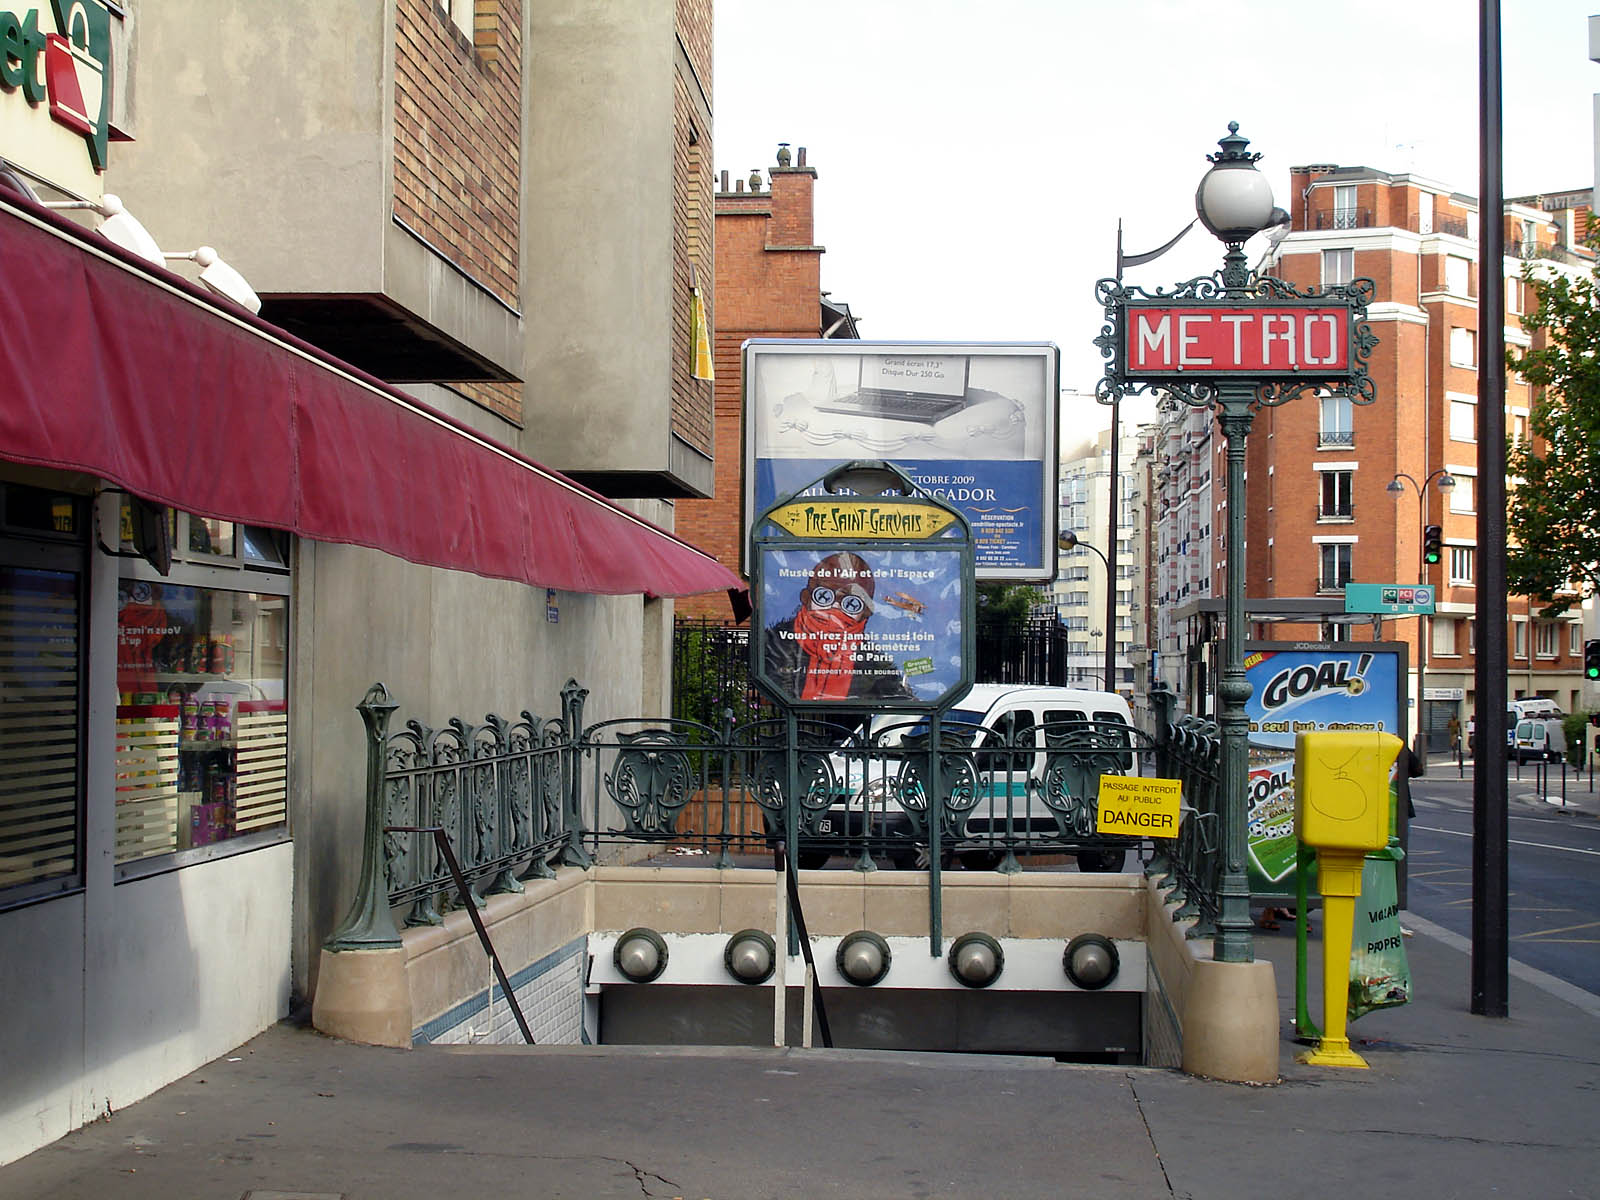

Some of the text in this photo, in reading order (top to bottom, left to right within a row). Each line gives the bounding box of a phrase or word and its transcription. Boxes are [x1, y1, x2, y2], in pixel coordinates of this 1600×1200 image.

[1138, 314, 1338, 365] METRO
[881, 368, 904, 377] Disque
[920, 370, 933, 378] 250
[911, 475, 975, 485] CTOBRE 2009
[907, 488, 996, 501] MOGADOR
[779, 568, 935, 580] Musée de l'Air et de l'Espace
[779, 631, 935, 643] Vous n'irez jamais aussi loin
[822, 643, 921, 653] qu'à 6 kilomètres
[1294, 642, 1331, 650] JCDecaux
[849, 653, 894, 662] de Paris
[1244, 651, 1263, 668] VEAU
[1248, 722, 1259, 732] n
[1262, 721, 1289, 733] seul
[1293, 721, 1316, 732] but
[1103, 782, 1177, 795] PASSAGE INTERDIT
[1117, 794, 1162, 804] AU PUBLIC
[1103, 810, 1173, 828] DANGER
